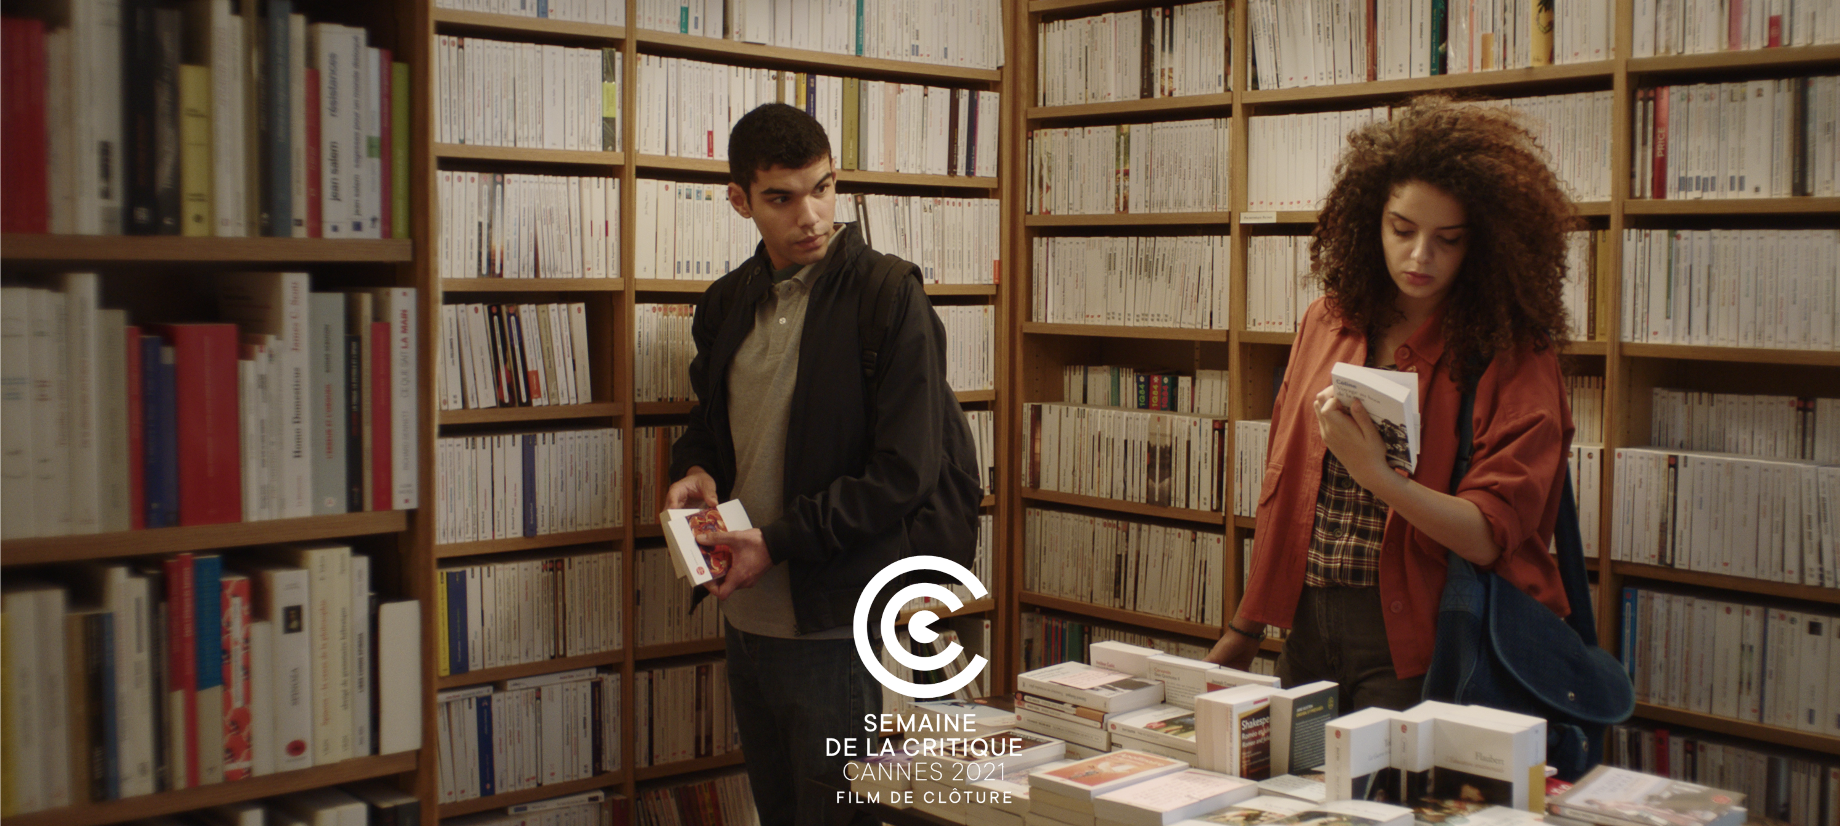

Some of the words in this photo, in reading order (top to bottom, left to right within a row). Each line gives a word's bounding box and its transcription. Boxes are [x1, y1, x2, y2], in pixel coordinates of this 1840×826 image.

[326, 52, 338, 118] résistances
[1657, 127, 1666, 157] PRICE
[328, 141, 340, 175] salem
[328, 177, 342, 202] jean
[400, 337, 408, 349] LA
[292, 367, 302, 424] Domesticus
[292, 428, 302, 459] Homo
[1241, 715, 1270, 730] Shakespe
[1475, 751, 1504, 764] Flaubert
